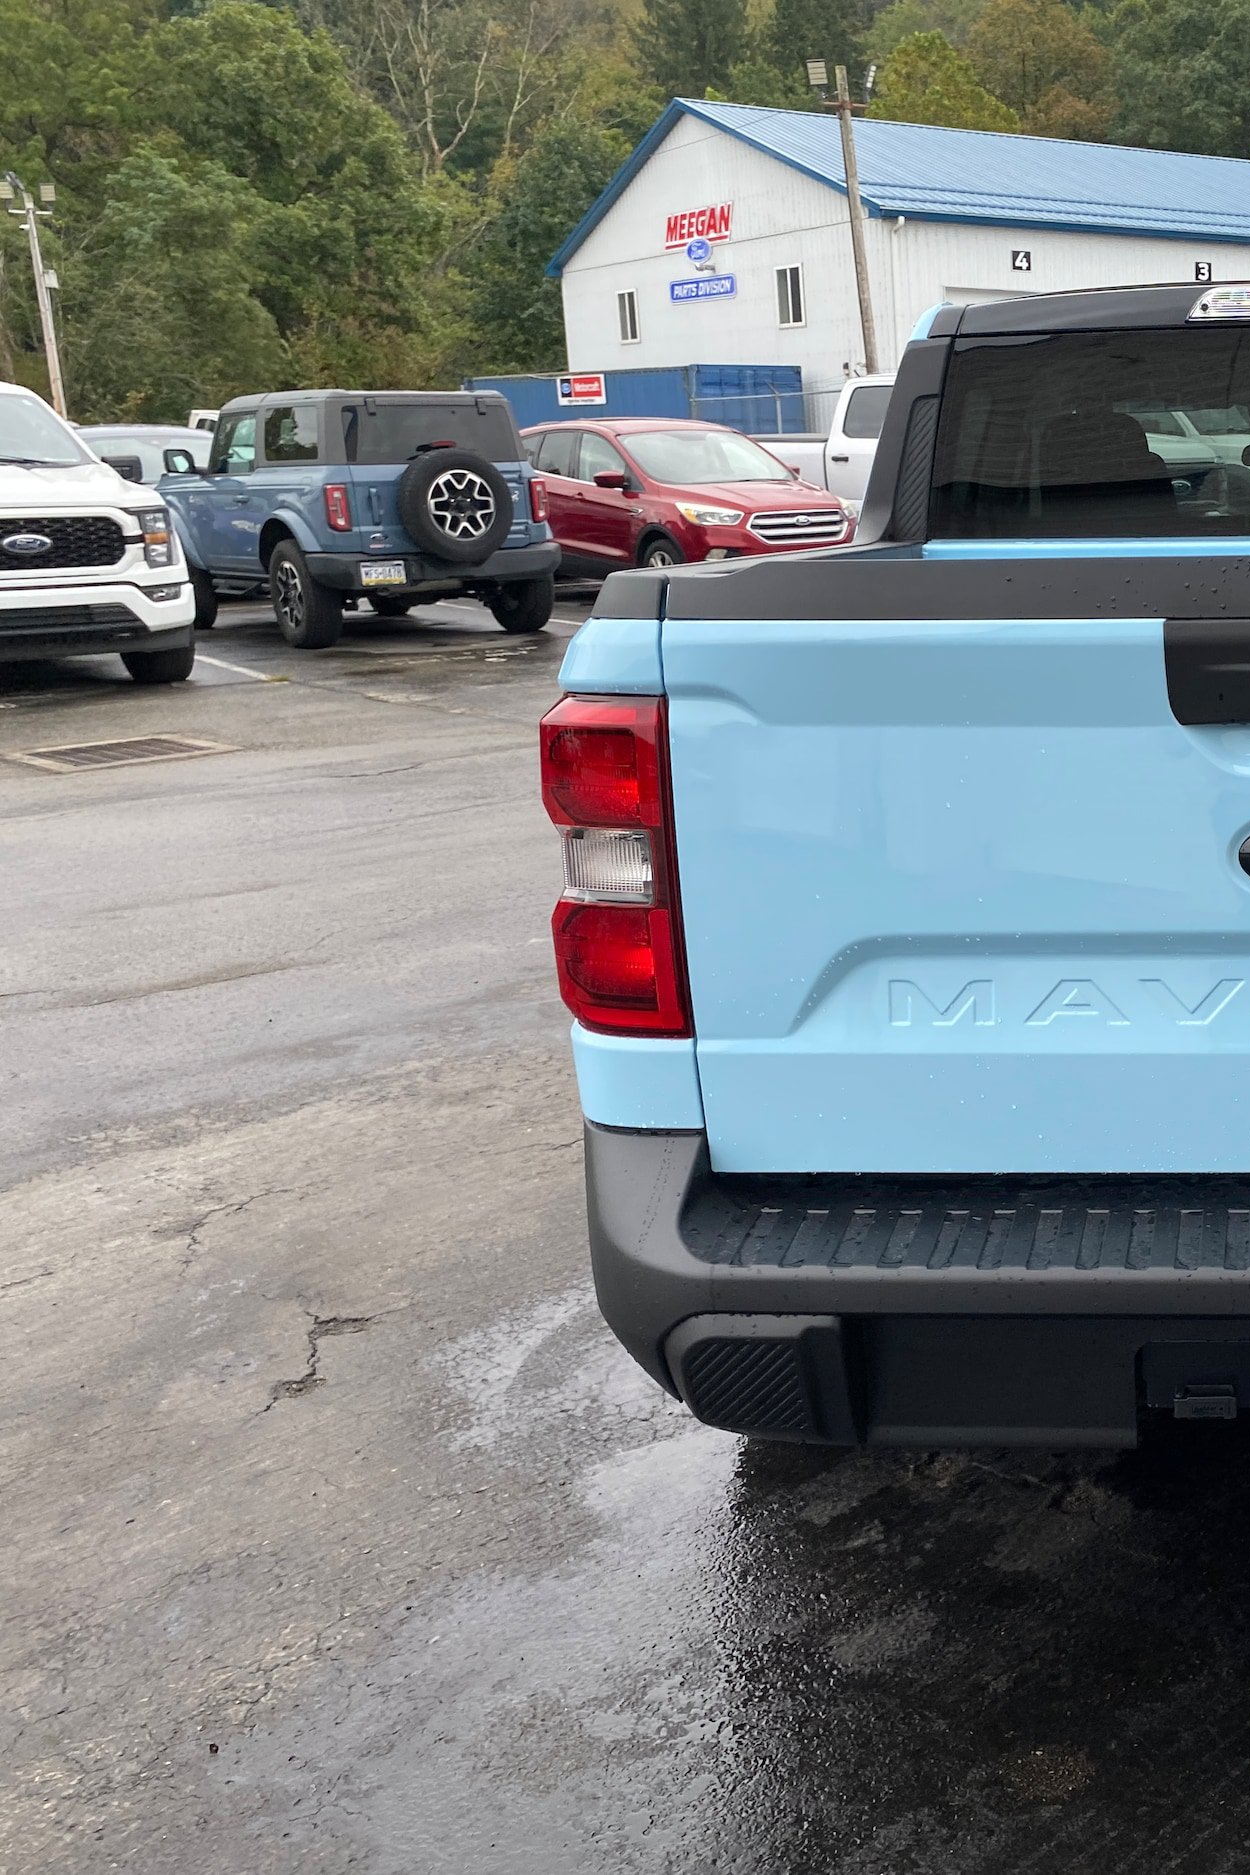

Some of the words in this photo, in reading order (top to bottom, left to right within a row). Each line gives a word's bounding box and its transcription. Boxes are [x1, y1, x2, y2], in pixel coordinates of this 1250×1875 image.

[666, 204, 731, 242] MEEGAN
[1015, 251, 1029, 270] 4
[1197, 262, 1210, 281] 3
[673, 283, 698, 299] PARTS
[698, 279, 732, 296] DIVISION
